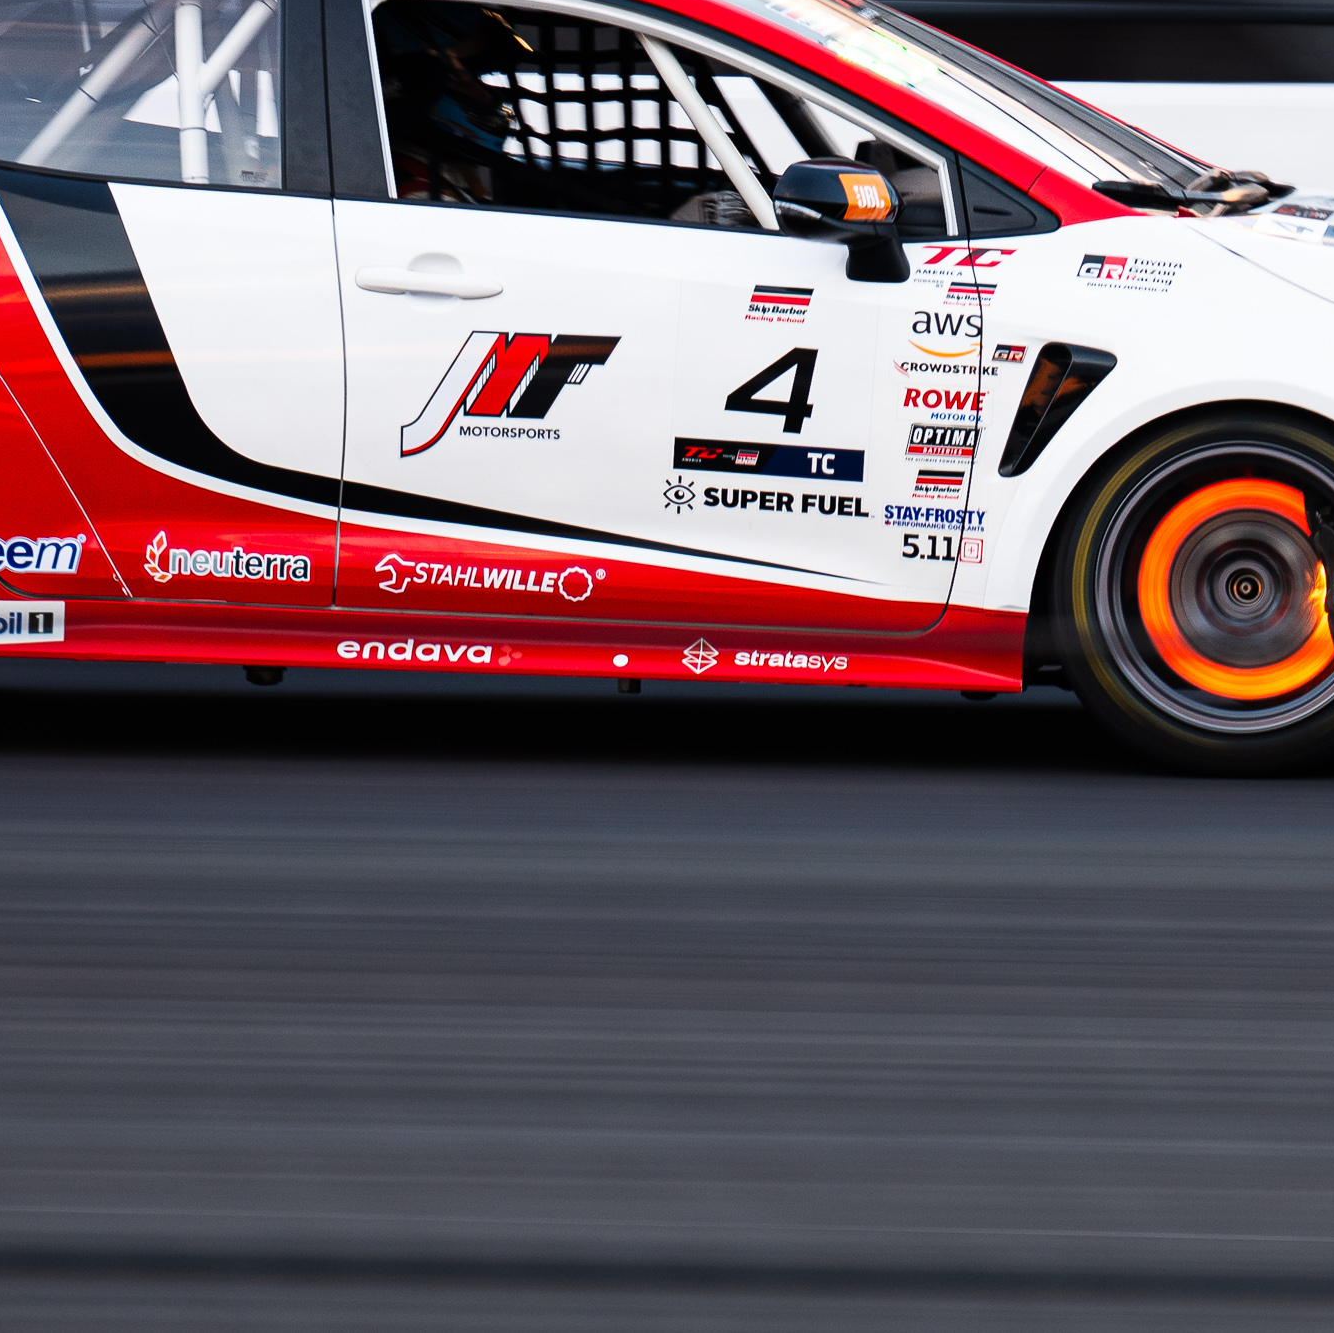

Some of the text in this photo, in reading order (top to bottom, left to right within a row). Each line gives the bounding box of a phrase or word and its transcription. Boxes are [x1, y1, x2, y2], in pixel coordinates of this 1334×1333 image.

[853, 185, 885, 209] JBL
[922, 245, 1018, 267] TC
[915, 268, 963, 277] AMERICA
[1077, 262, 1125, 280] GR
[744, 313, 806, 324] Racing School
[748, 304, 808, 316] Skip Barber
[911, 310, 983, 338] aws
[900, 361, 999, 376] CROWDSTRKE
[400, 330, 622, 458] JMF
[724, 347, 819, 434] 4
[903, 386, 987, 411] ROWE
[930, 412, 966, 421] MOTOR
[459, 425, 561, 440] MOTORSPORTS
[912, 427, 976, 447] OPTIMA
[684, 446, 723, 459] TC
[922, 446, 963, 456] BATTERIES
[807, 451, 836, 475] TC
[914, 485, 961, 495] Skip Barber
[703, 487, 870, 518] SUPER FUEL
[884, 504, 986, 525] STAY-FROSTY
[892, 520, 946, 530] PERFORMANCE
[902, 533, 956, 562] 5.11
[170, 549, 310, 580] neuterra
[413, 562, 558, 593] STAHLWILLE
[336, 638, 493, 665] endava
[734, 650, 849, 673] stratasys
